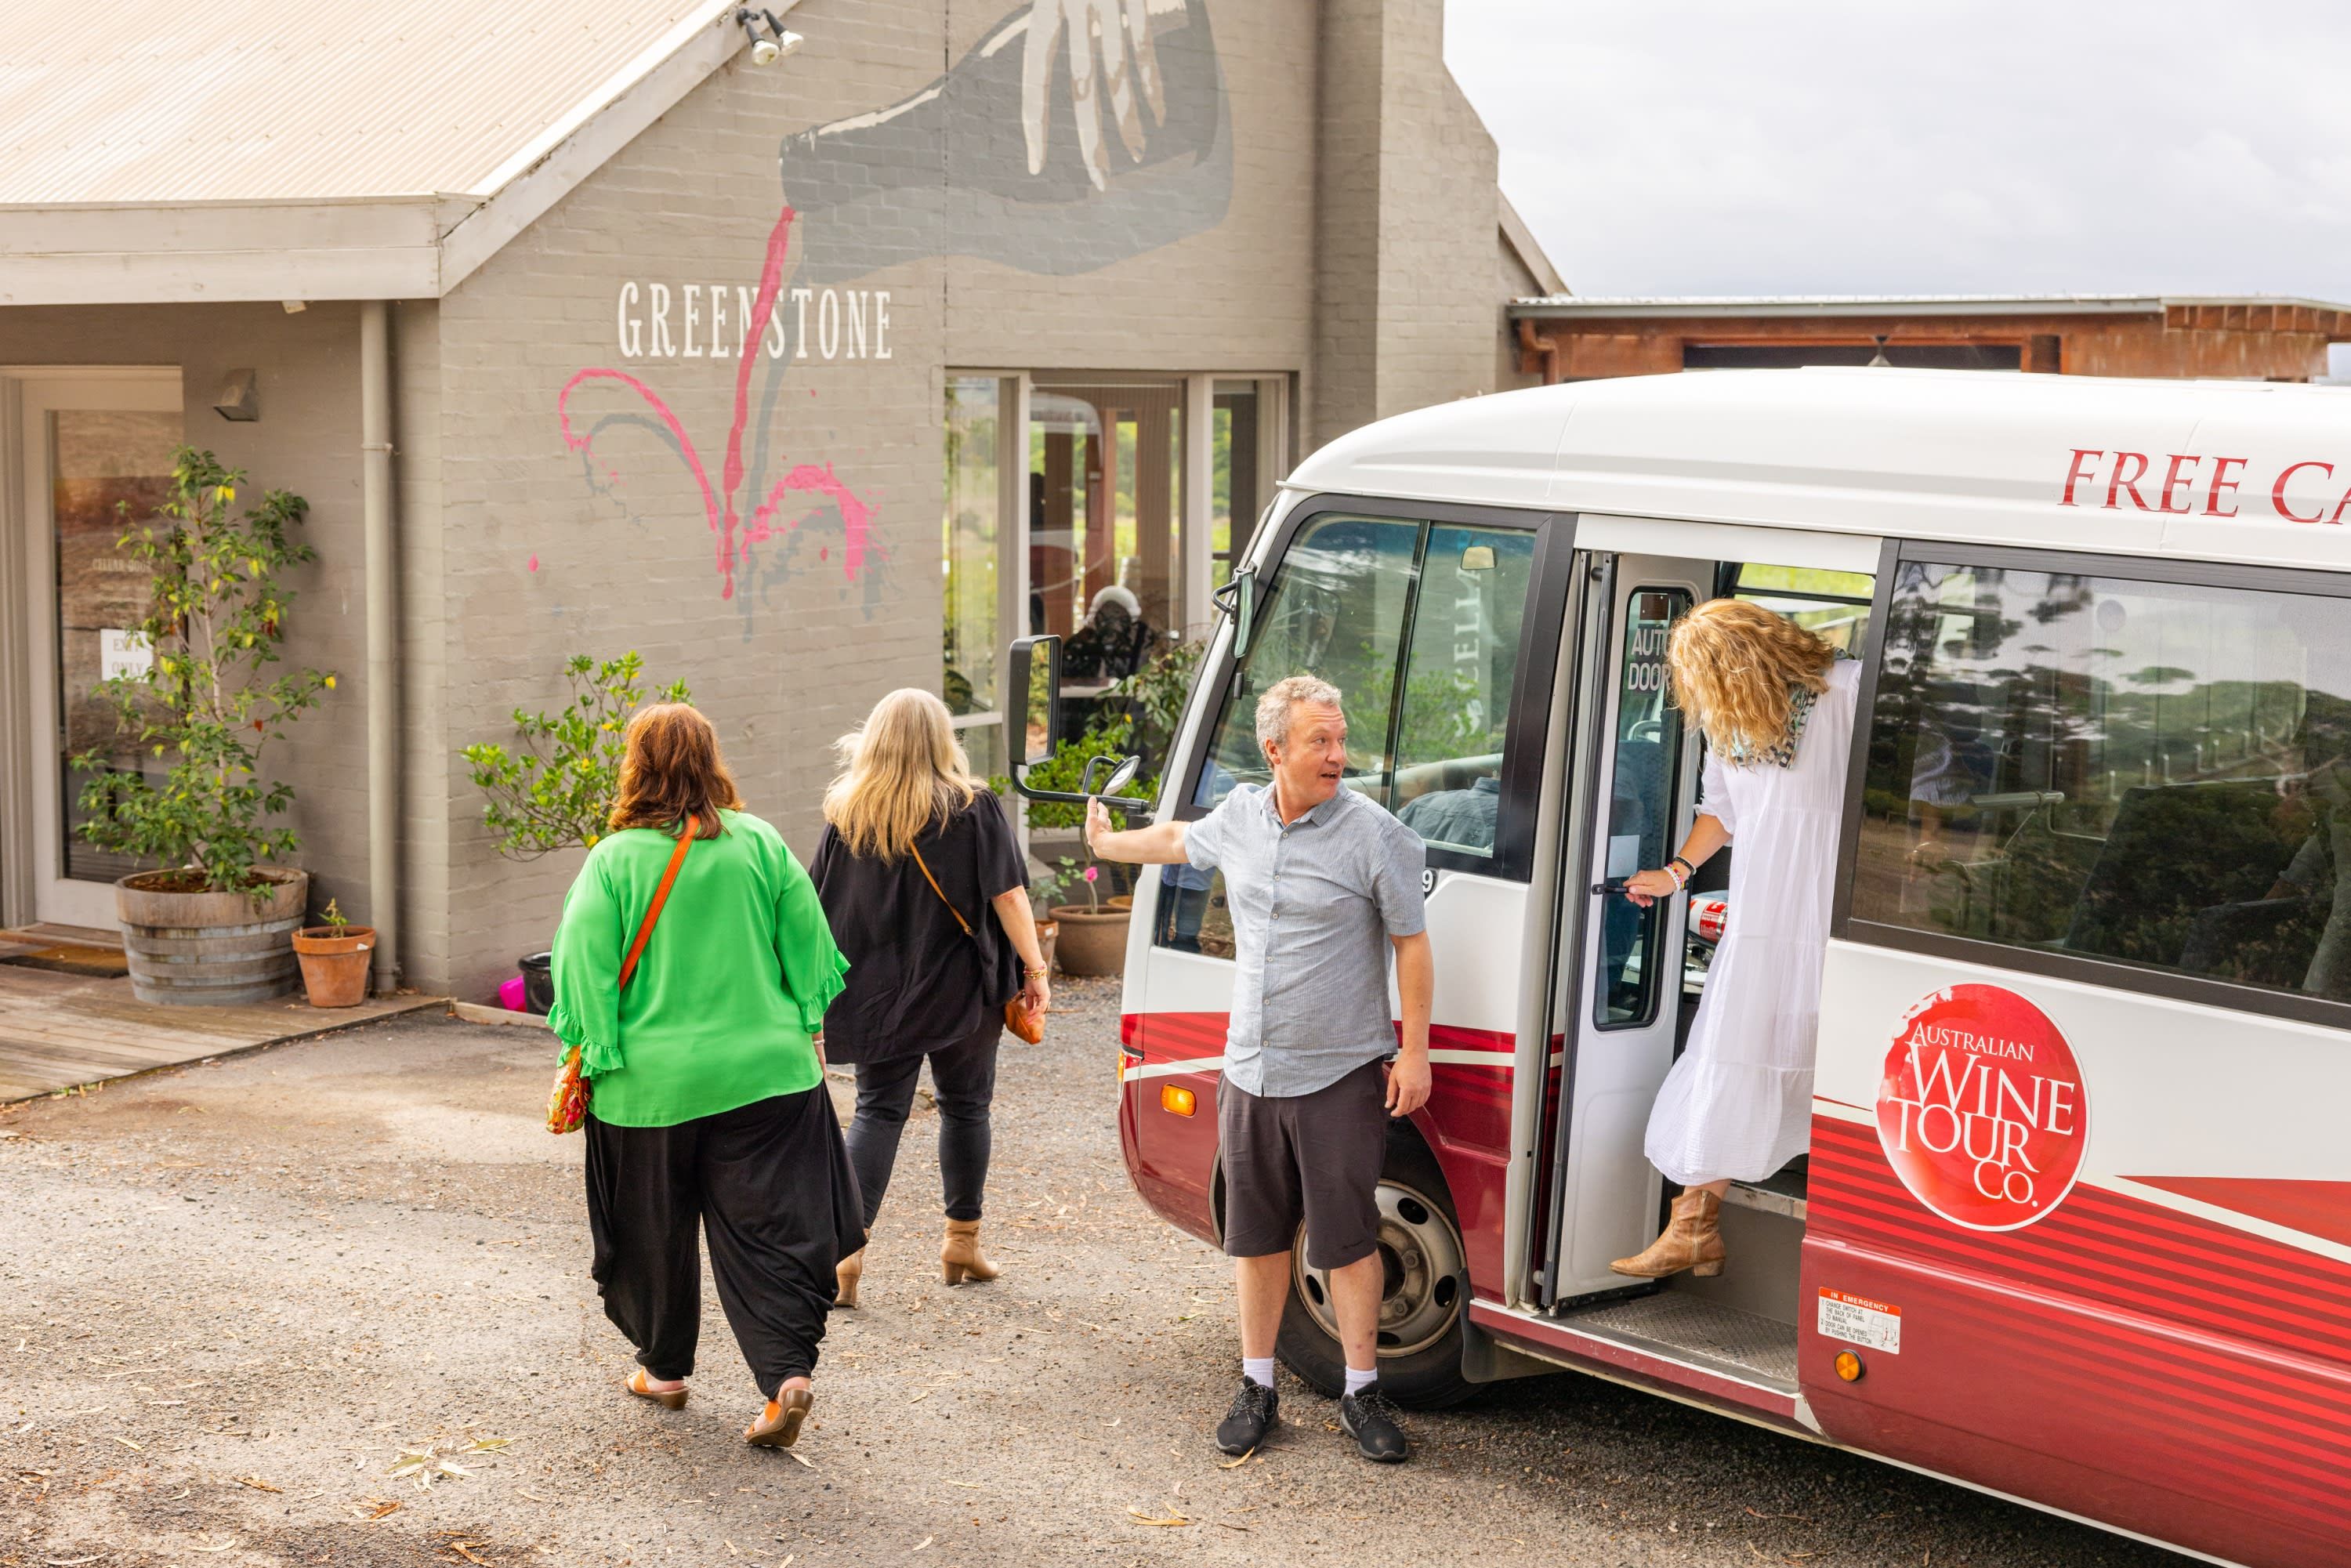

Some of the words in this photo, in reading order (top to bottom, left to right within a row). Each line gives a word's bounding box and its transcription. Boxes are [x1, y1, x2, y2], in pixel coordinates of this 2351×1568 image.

[618, 281, 893, 360] GREENSTONE
[2057, 448, 2248, 517] FREE
[1628, 662, 1671, 691] DOOR
[1911, 1021, 2034, 1063] AUSTRALIAN
[1904, 1041, 2075, 1135] WINE
[1886, 1095, 2040, 1173] TOUR
[1973, 1158, 2038, 1208] CO.
[1826, 1301, 1841, 1309] CHANGE
[1842, 1295, 1889, 1312] EMERGENCY
[1853, 1313, 1865, 1322] PANEL
[1832, 1315, 1847, 1324] MANUAL
[1853, 1327, 1867, 1337] OPENED
[1831, 1328, 1847, 1338] PUSHING
[1857, 1334, 1871, 1344] BUTTON
